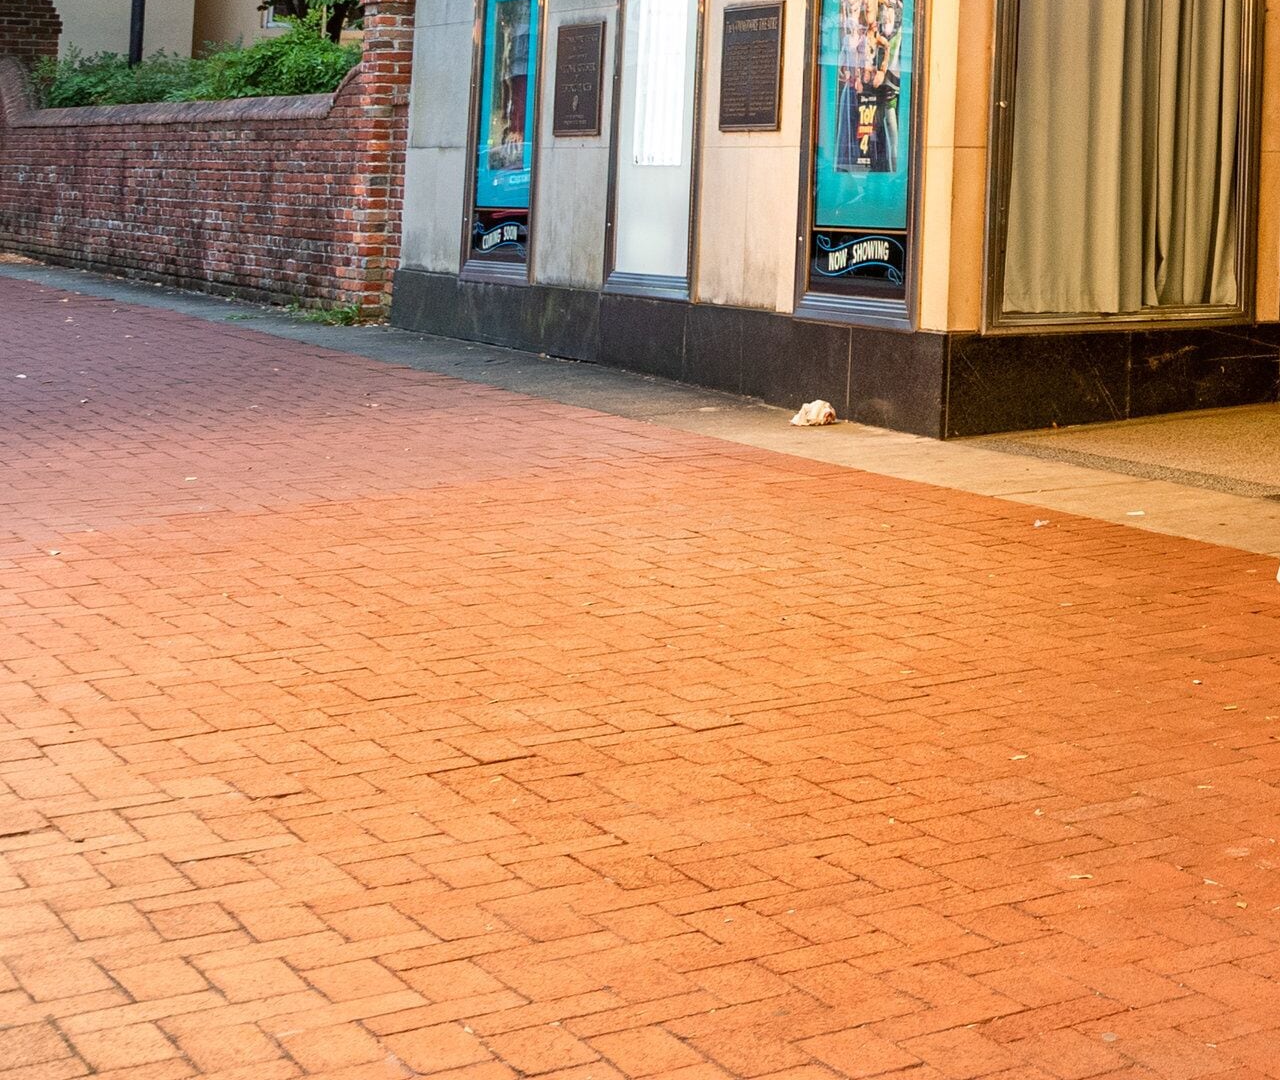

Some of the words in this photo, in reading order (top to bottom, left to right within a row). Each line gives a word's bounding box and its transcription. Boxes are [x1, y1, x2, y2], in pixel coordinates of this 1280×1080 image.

[858, 104, 877, 126] TOY
[860, 134, 870, 154] 4
[828, 248, 848, 271] NOW
[853, 240, 889, 264] SHOWING
